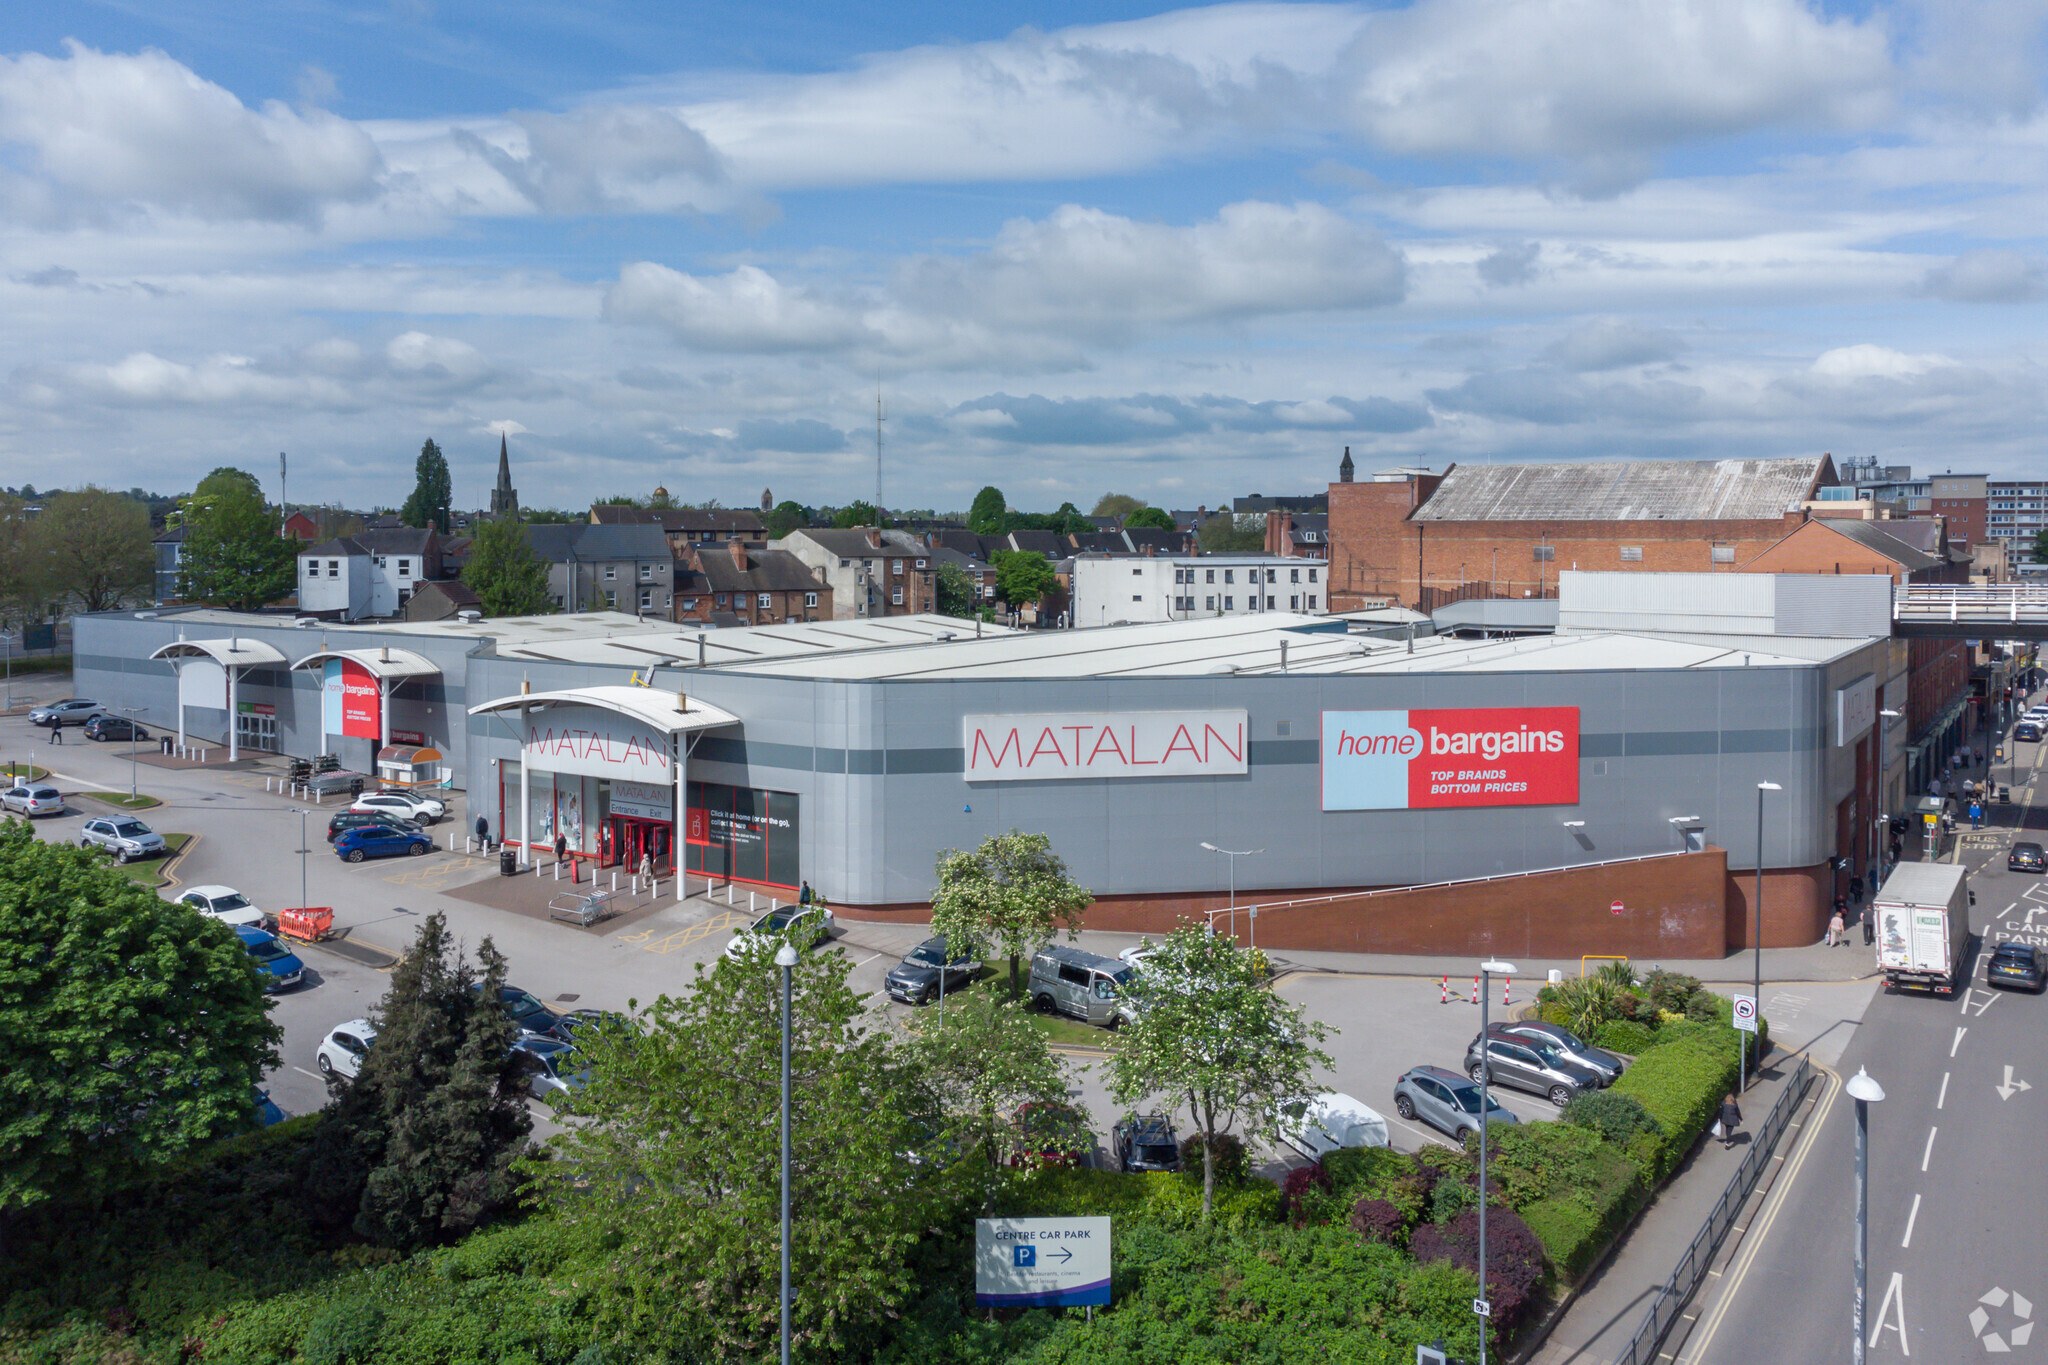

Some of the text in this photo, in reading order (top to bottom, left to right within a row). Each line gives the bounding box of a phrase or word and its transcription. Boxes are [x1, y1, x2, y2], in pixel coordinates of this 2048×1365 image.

[327, 683, 376, 696] home bargains
[392, 730, 420, 741] bargains
[1337, 725, 1564, 760] home bargains
[529, 726, 667, 768] MATALAN
[971, 723, 1243, 769] MATALAN
[1431, 769, 1507, 780] TOP BRANDS
[615, 785, 666, 802] MATALAN
[1431, 782, 1528, 794] BOTTOM PRICES
[611, 804, 662, 818] Entrance Exit
[1966, 835, 1998, 843] BUS
[2006, 920, 2048, 934] CAR
[995, 1230, 1091, 1240] CENTRE CAR PARK
[1019, 1248, 1030, 1264] P
